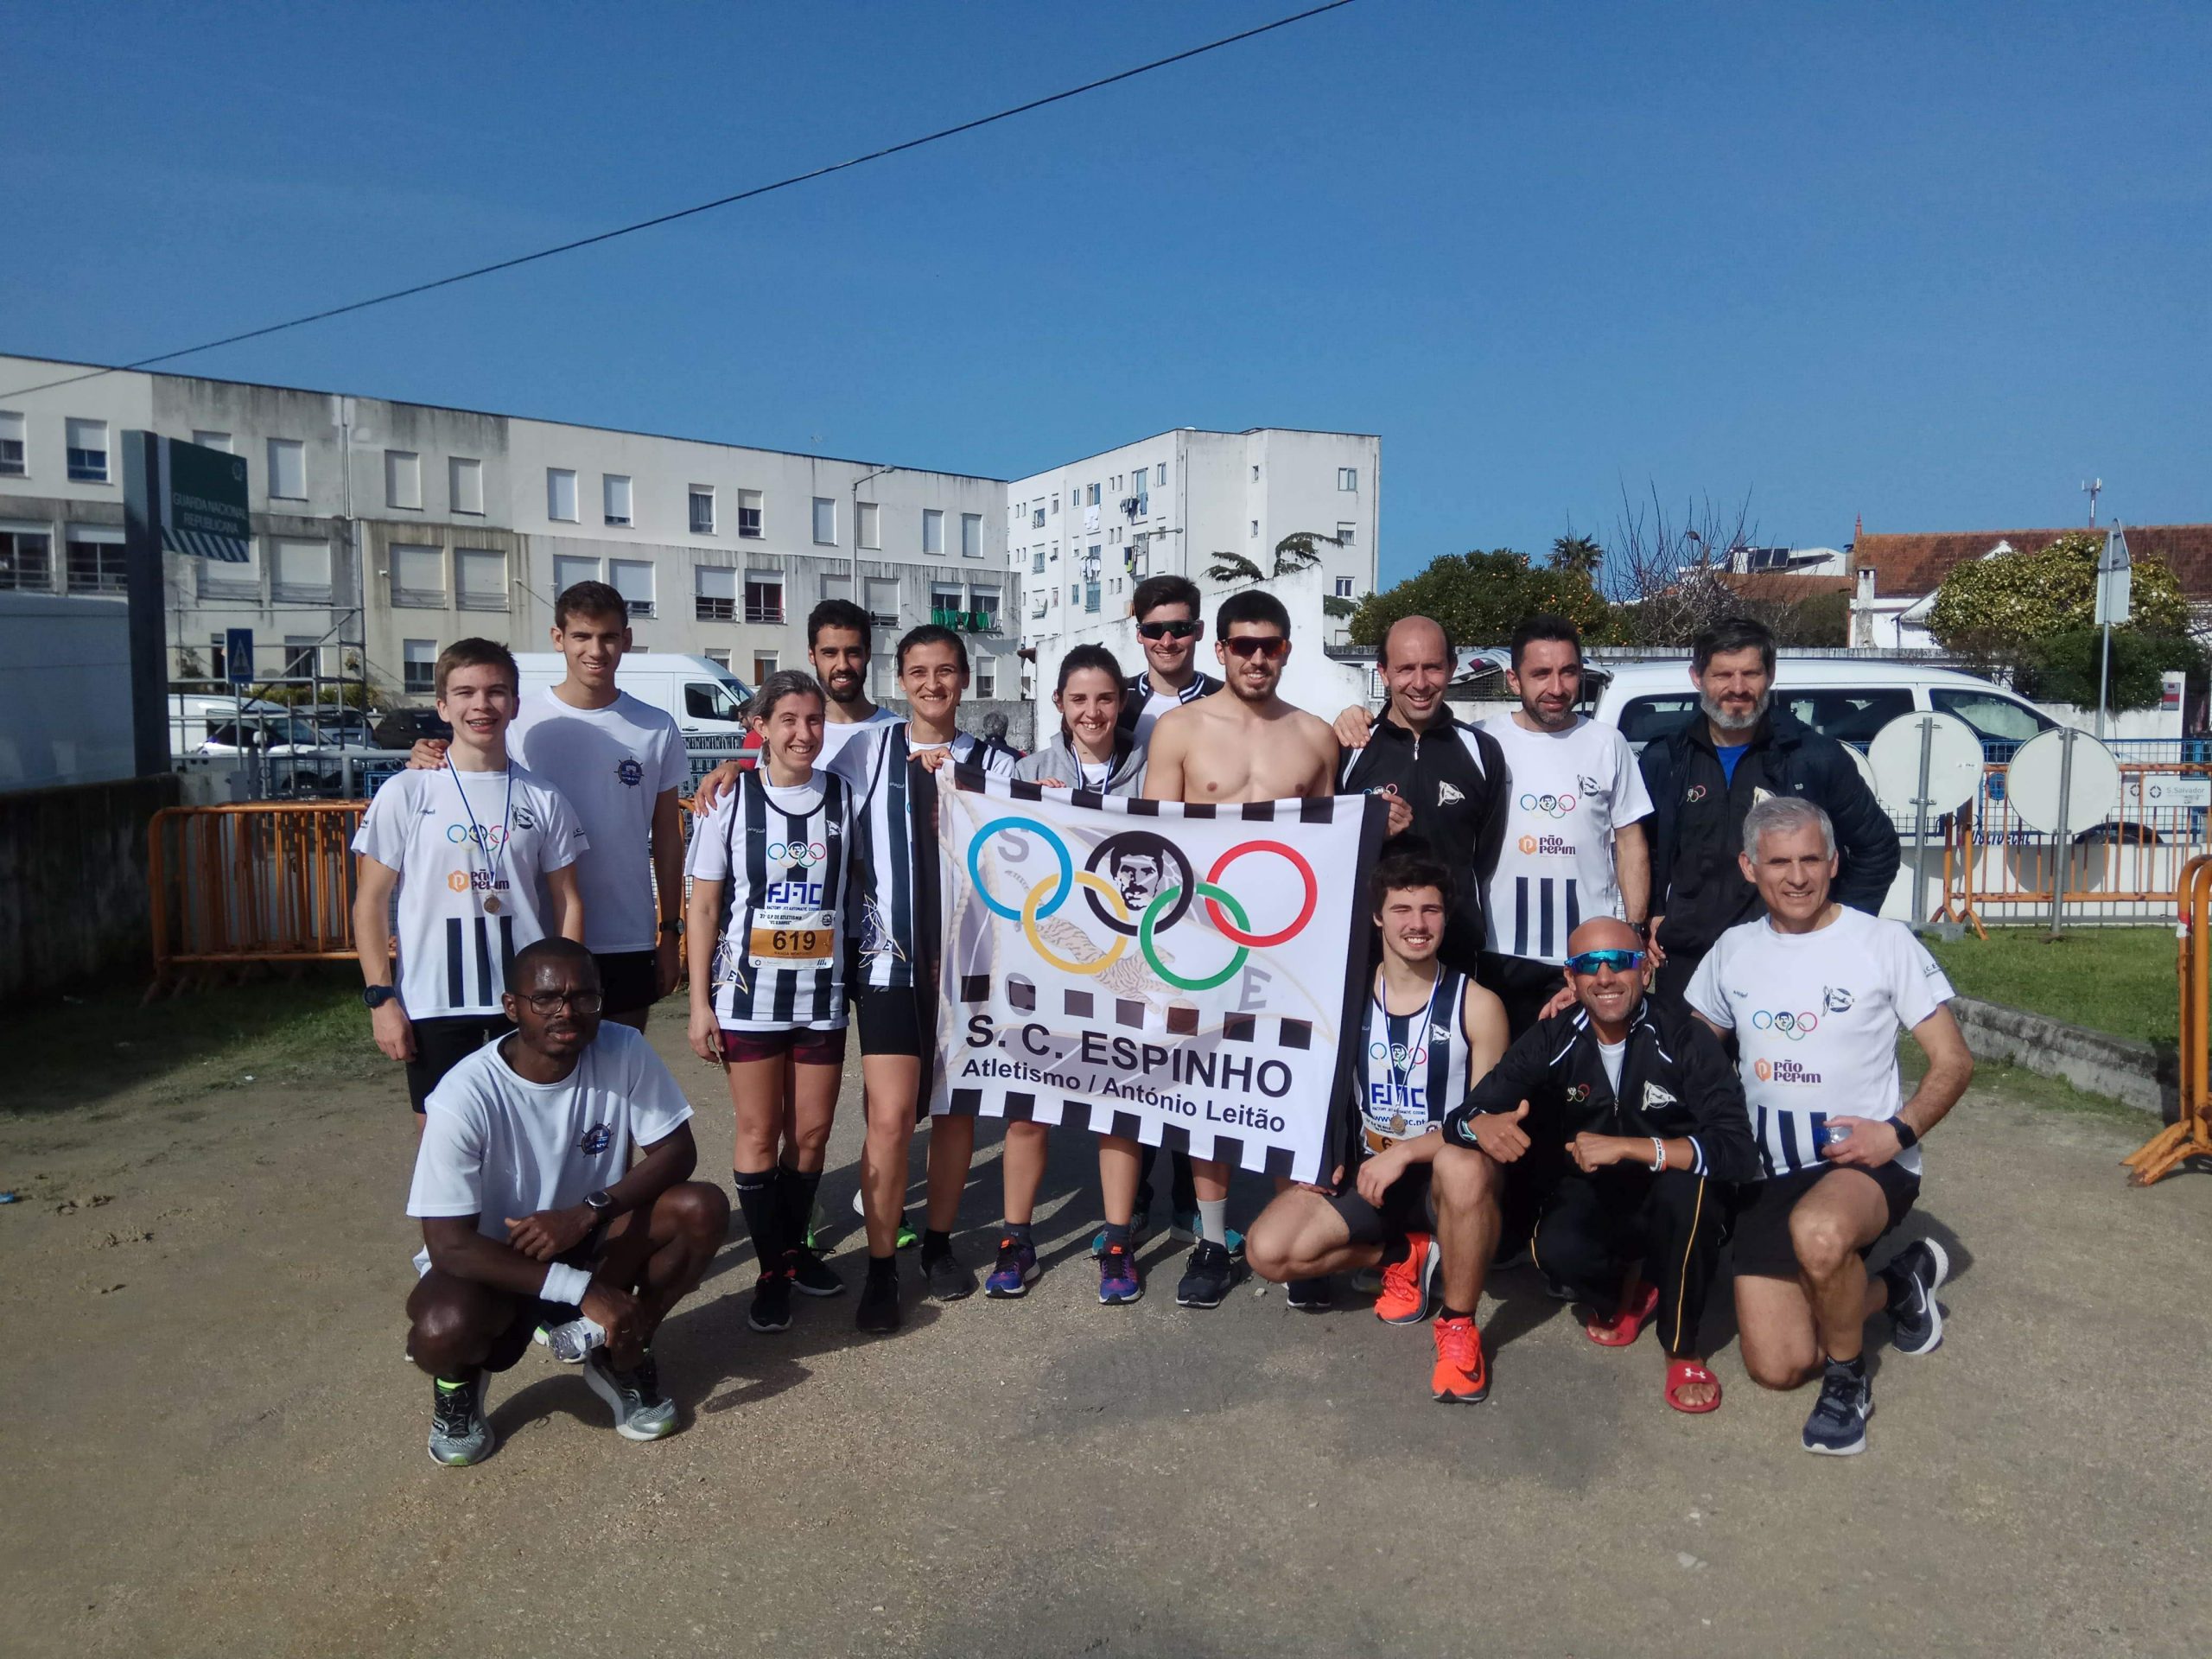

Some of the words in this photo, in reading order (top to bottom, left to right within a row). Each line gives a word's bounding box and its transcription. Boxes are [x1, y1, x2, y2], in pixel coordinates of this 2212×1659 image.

[772, 930, 817, 950] 619
[1236, 964, 1272, 1012] E
[965, 1014, 1006, 1048] S.
[1021, 1023, 1063, 1059] C.
[1081, 1030, 1293, 1098] ESPINHO
[961, 1058, 1081, 1090] Atletismo
[1088, 1074, 1096, 1093] /
[1102, 1077, 1198, 1116] António
[1206, 1100, 1286, 1133] Leitão
